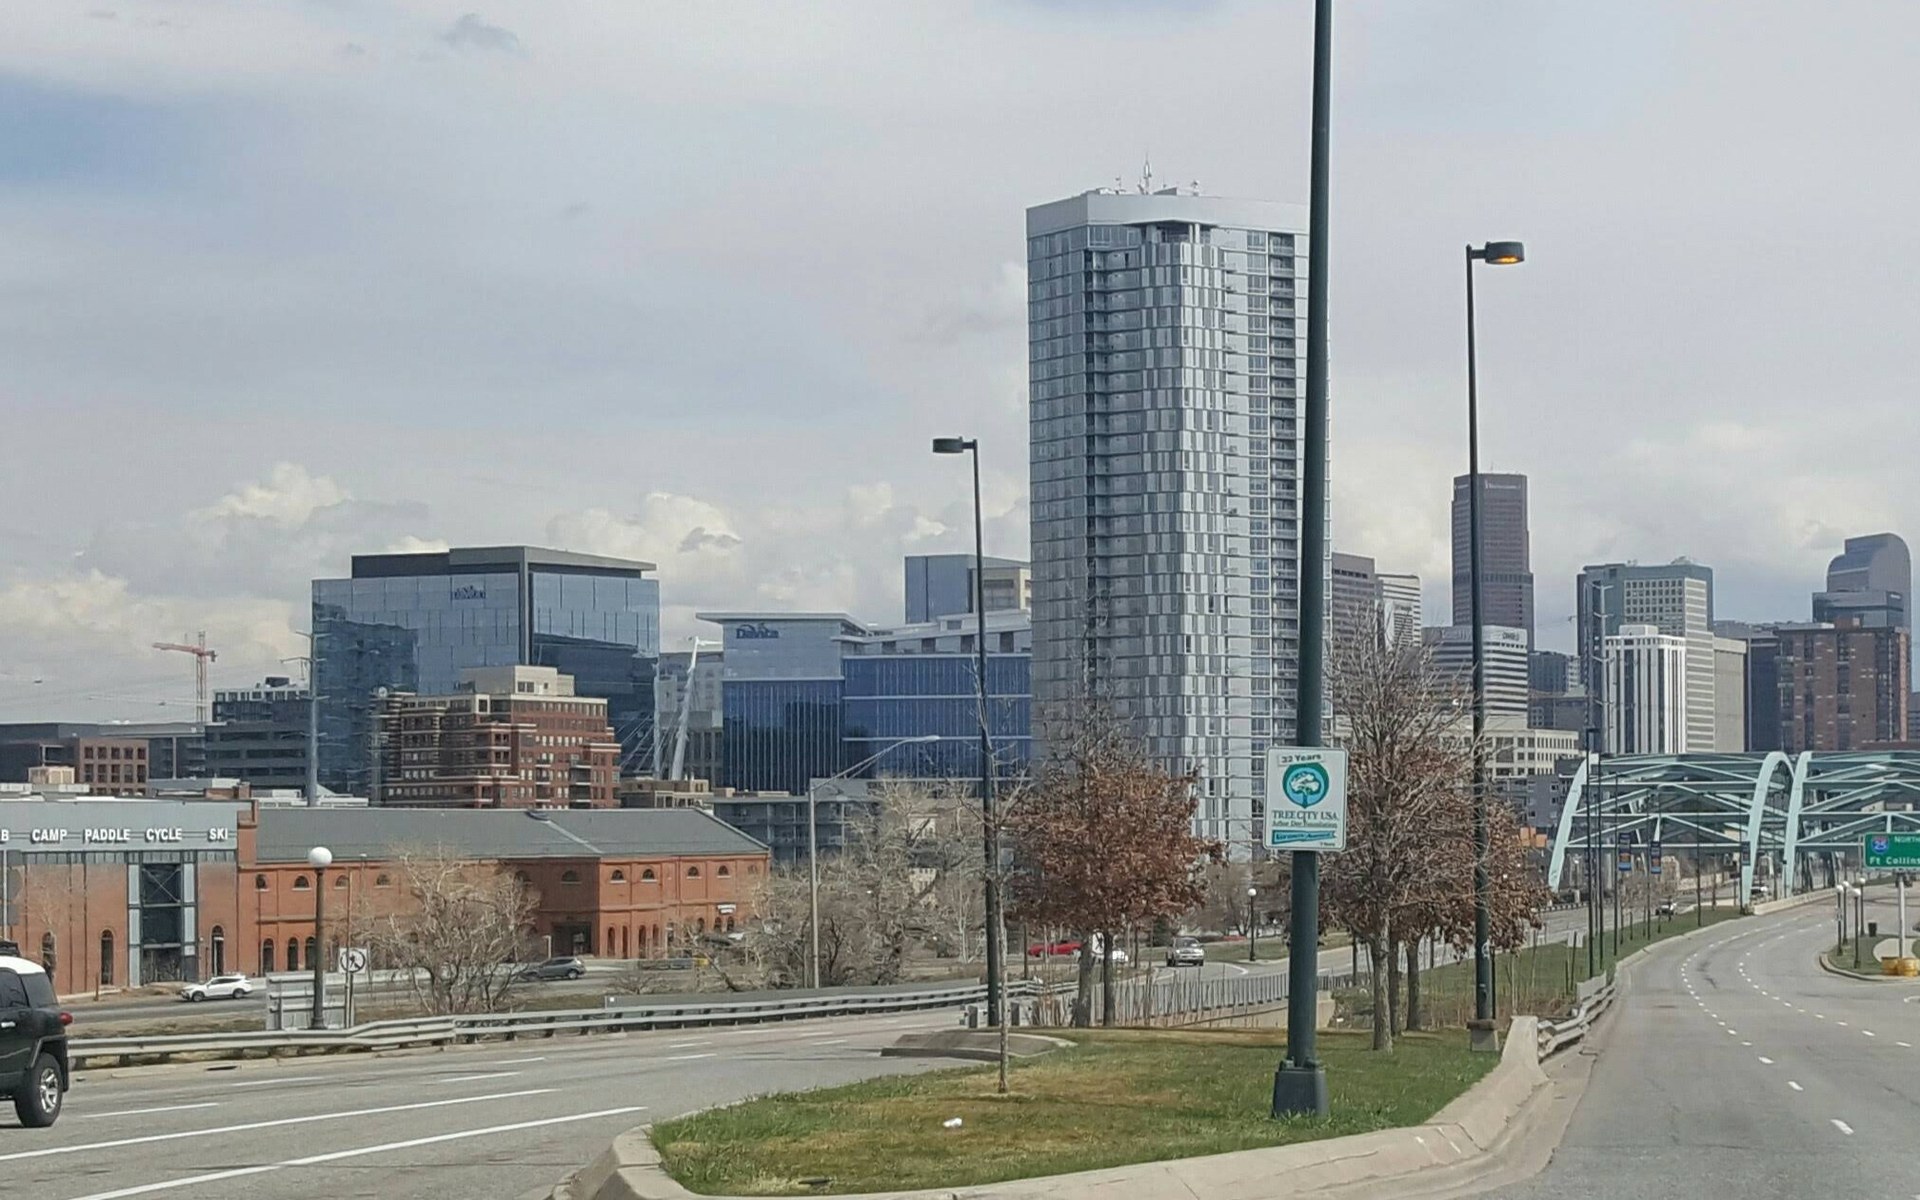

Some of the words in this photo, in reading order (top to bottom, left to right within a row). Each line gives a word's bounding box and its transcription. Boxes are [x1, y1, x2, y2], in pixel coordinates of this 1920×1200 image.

[1294, 753, 1322, 762] Years
[1272, 810, 1296, 819] TREE
[1296, 810, 1319, 824] CITY
[1320, 810, 1338, 820] USA
[31, 828, 68, 842] CAMP
[84, 828, 131, 842] PADDLE
[146, 828, 183, 842] CYCLE
[208, 828, 229, 841] SKI
[1874, 840, 1887, 850] 25
[1869, 856, 1881, 865] Ft
